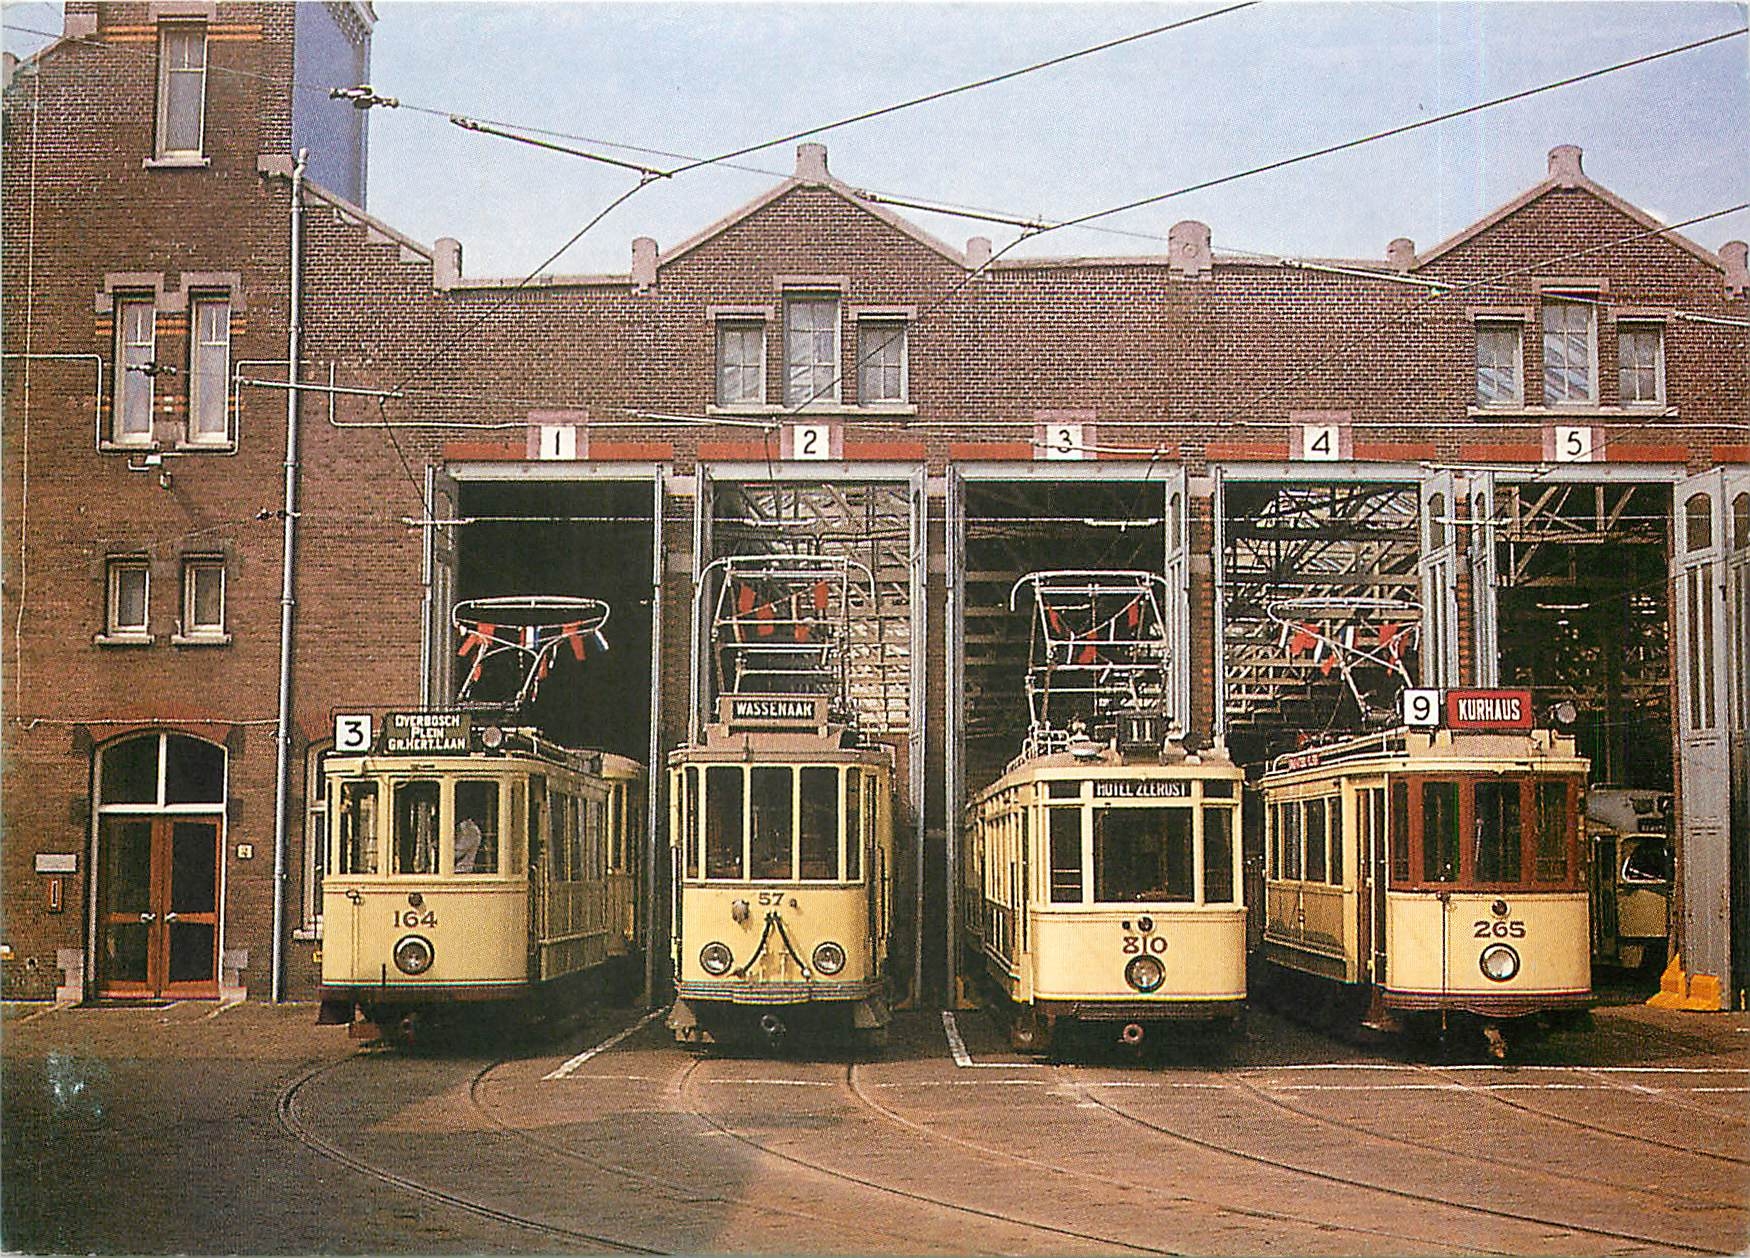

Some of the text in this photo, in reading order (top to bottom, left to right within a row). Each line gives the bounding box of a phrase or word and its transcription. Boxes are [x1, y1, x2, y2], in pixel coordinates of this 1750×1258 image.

[555, 429, 561, 456] 1
[803, 429, 818, 455] 2
[1058, 429, 1073, 454] 3
[1311, 430, 1331, 456] 4
[1567, 431, 1583, 456] 5
[736, 701, 813, 717] WASSENAAR
[1412, 695, 1431, 721] 9
[1457, 698, 1521, 722] KURHAUS
[343, 720, 364, 747] 3
[410, 726, 445, 739] PLEIN
[1096, 782, 1134, 797] HOTEL
[758, 892, 785, 906] 57
[394, 910, 438, 928] 164
[1473, 920, 1527, 938] 265
[1122, 936, 1168, 954] 810
